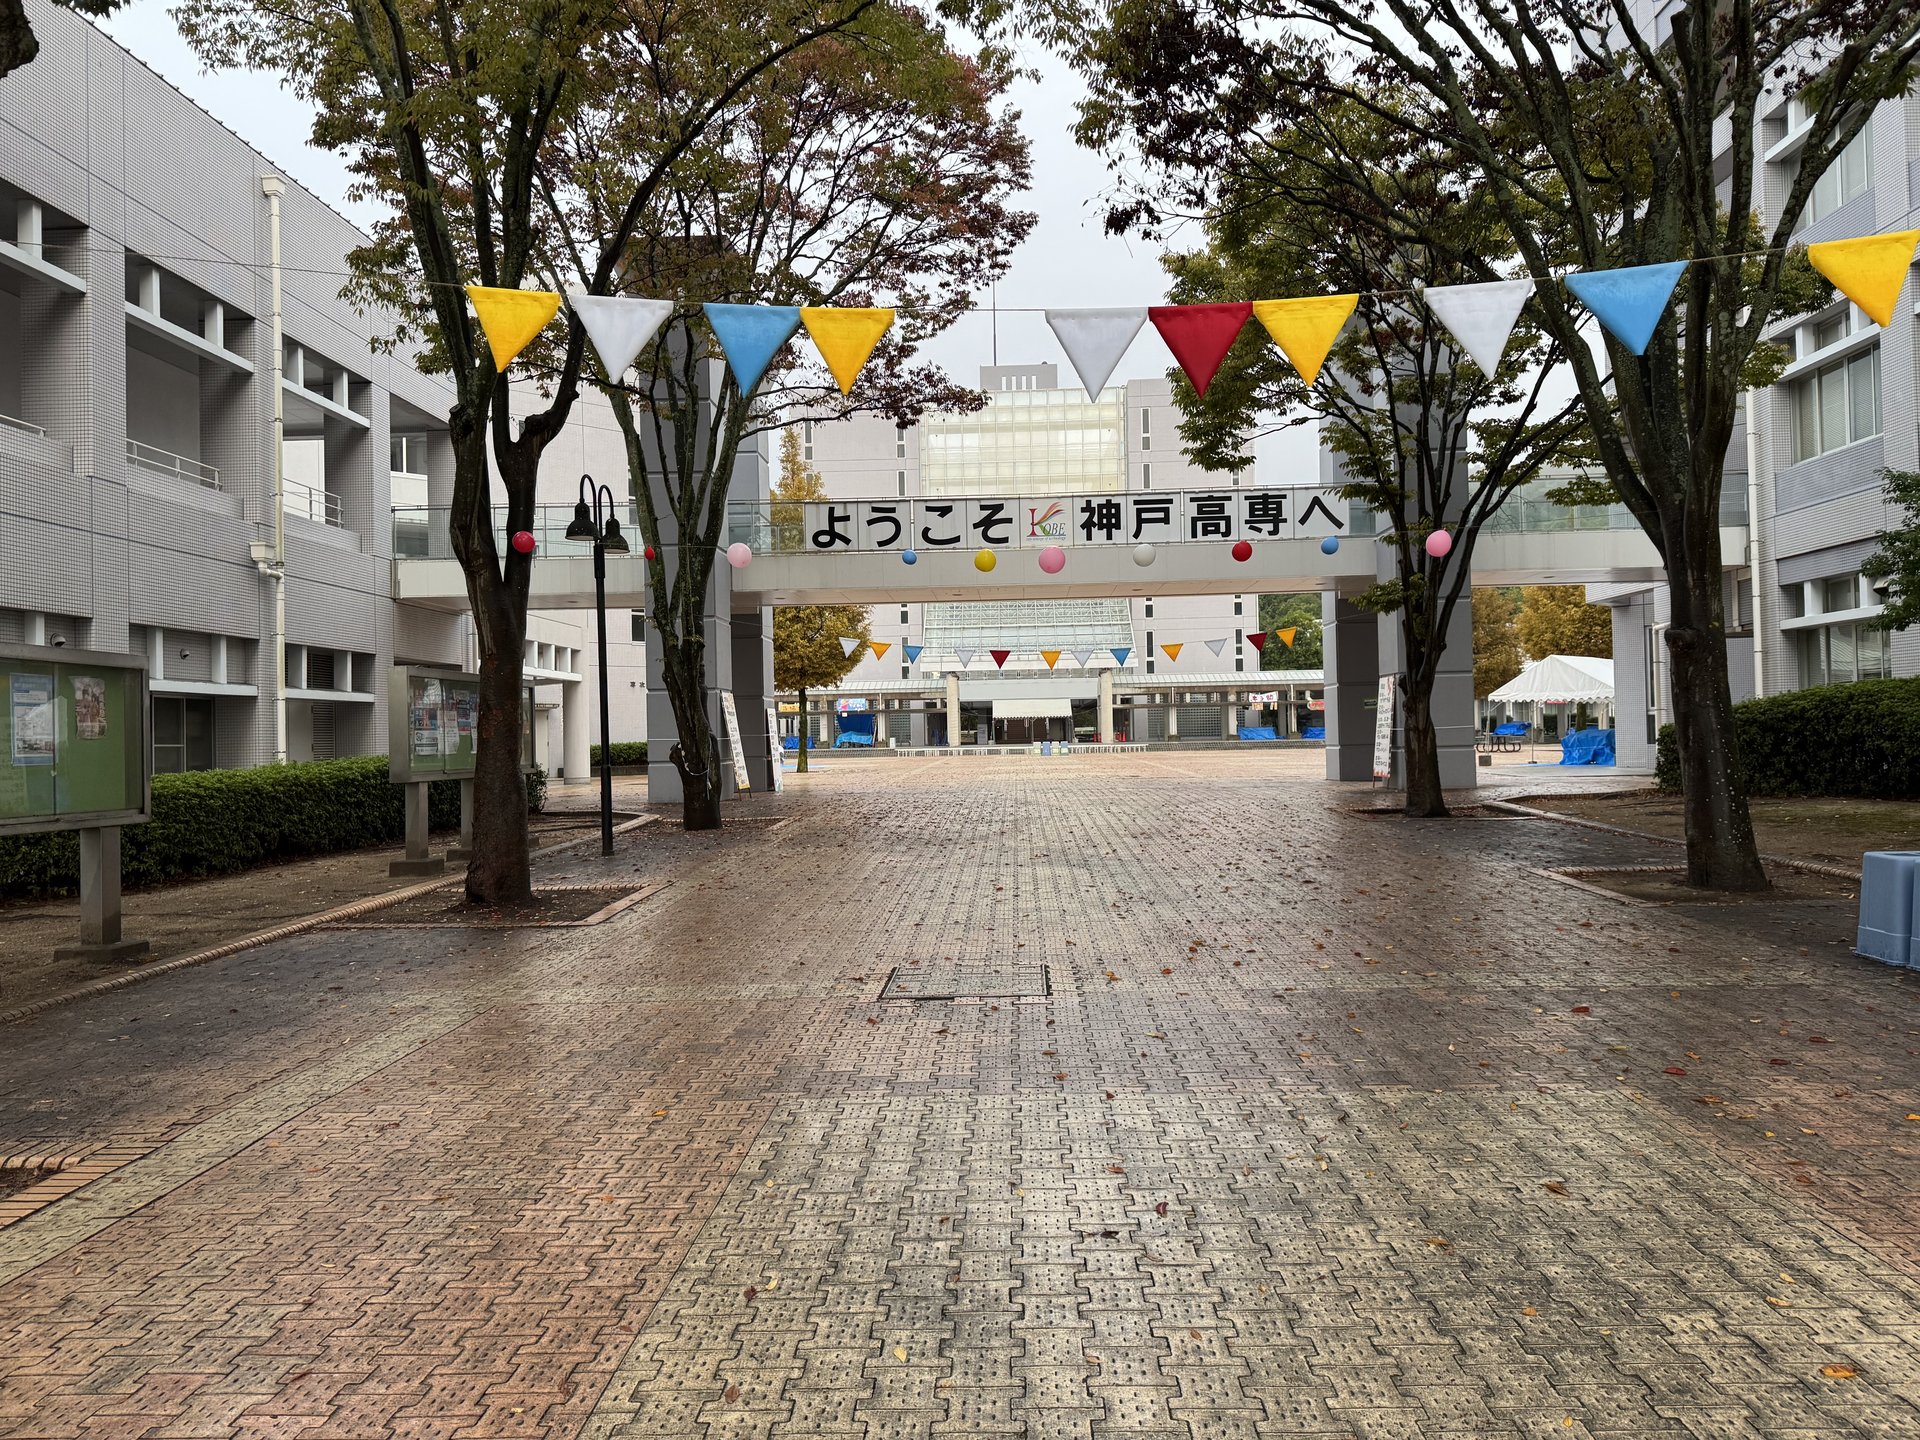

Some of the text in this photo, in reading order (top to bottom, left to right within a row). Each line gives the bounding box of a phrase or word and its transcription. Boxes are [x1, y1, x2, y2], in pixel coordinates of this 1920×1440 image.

[812, 503, 1013, 548] ようこそ
[1080, 493, 1345, 541] 神戸高専へ
